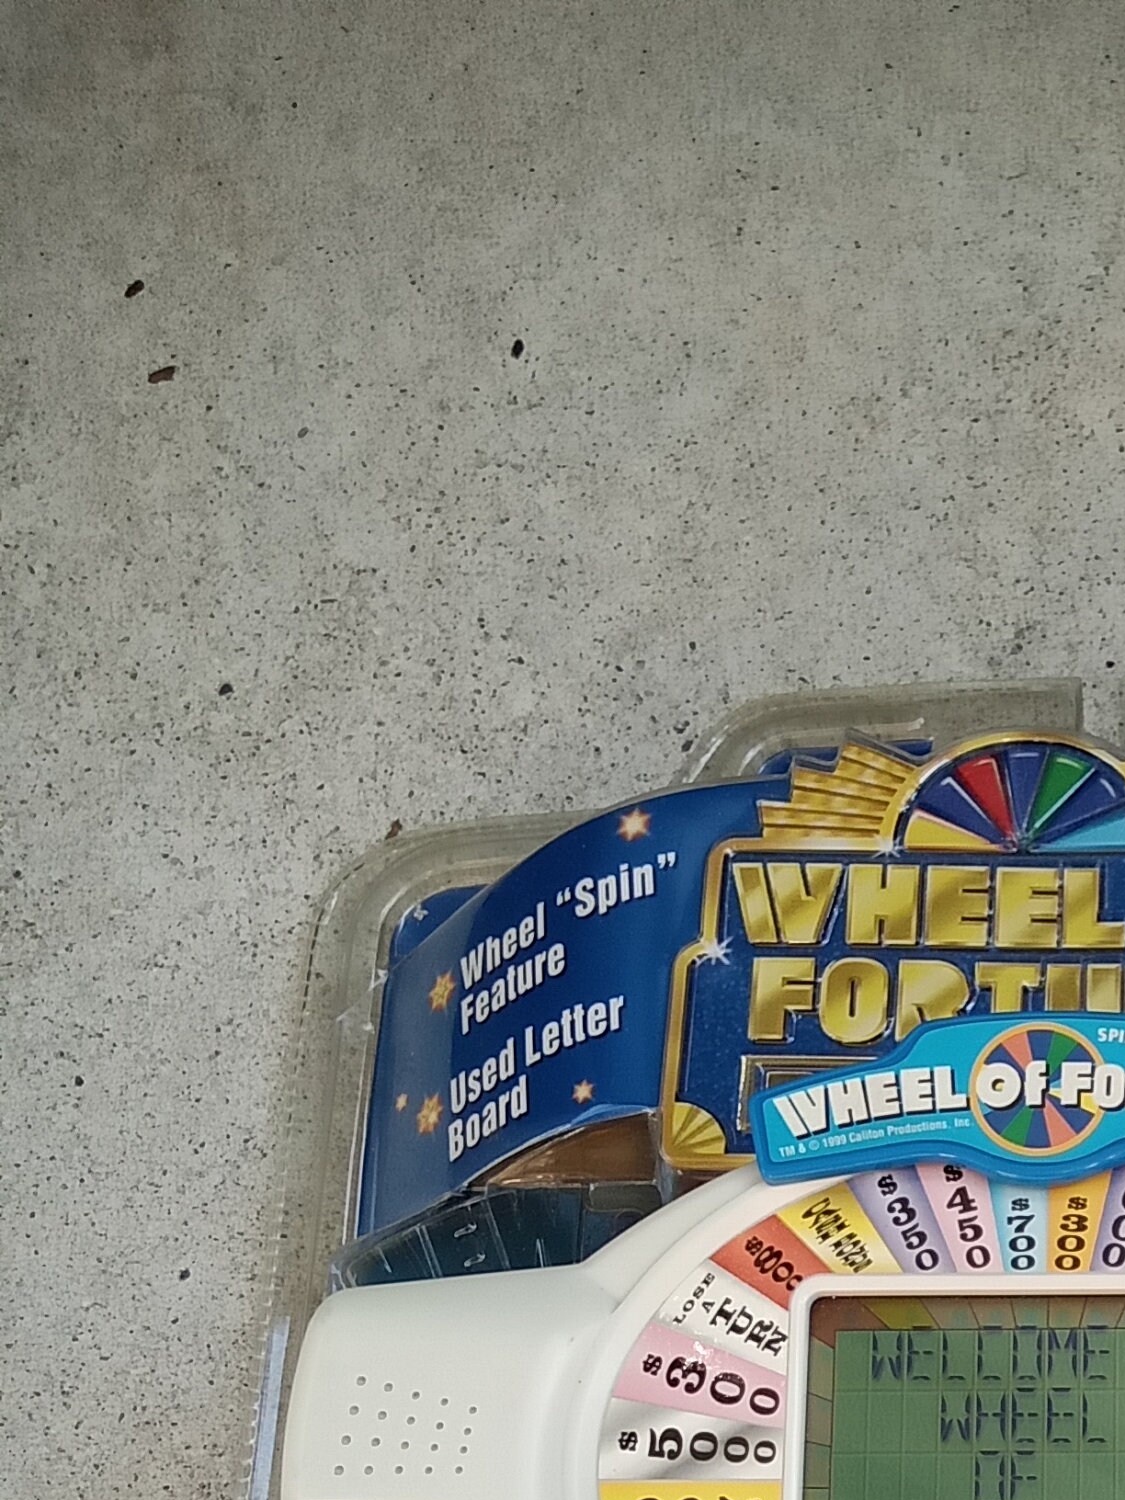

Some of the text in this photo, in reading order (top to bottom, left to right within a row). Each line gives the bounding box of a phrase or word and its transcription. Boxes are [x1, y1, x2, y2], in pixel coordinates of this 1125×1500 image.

[459, 852, 677, 992] Wheel “Spin”
[460, 942, 566, 1036] Feature
[450, 995, 625, 1114] Used Letter
[447, 1078, 530, 1163] Board
[772, 1065, 971, 1141] WHEEL
[779, 1146, 795, 1158] TM
[822, 1133, 847, 1148] 1999
[877, 1174, 941, 1272] $350
[942, 1162, 993, 1270] $450
[1006, 1197, 1036, 1272] $700
[1054, 1196, 1089, 1272] $300
[673, 1272, 716, 1325] LOSE
[701, 1300, 716, 1314] A
[709, 1297, 789, 1358] TURN
[642, 1353, 780, 1416] $300
[872, 1325, 1111, 1380] WELCOME
[618, 1427, 777, 1464] $5000
[940, 1386, 1108, 1444] WHEEL
